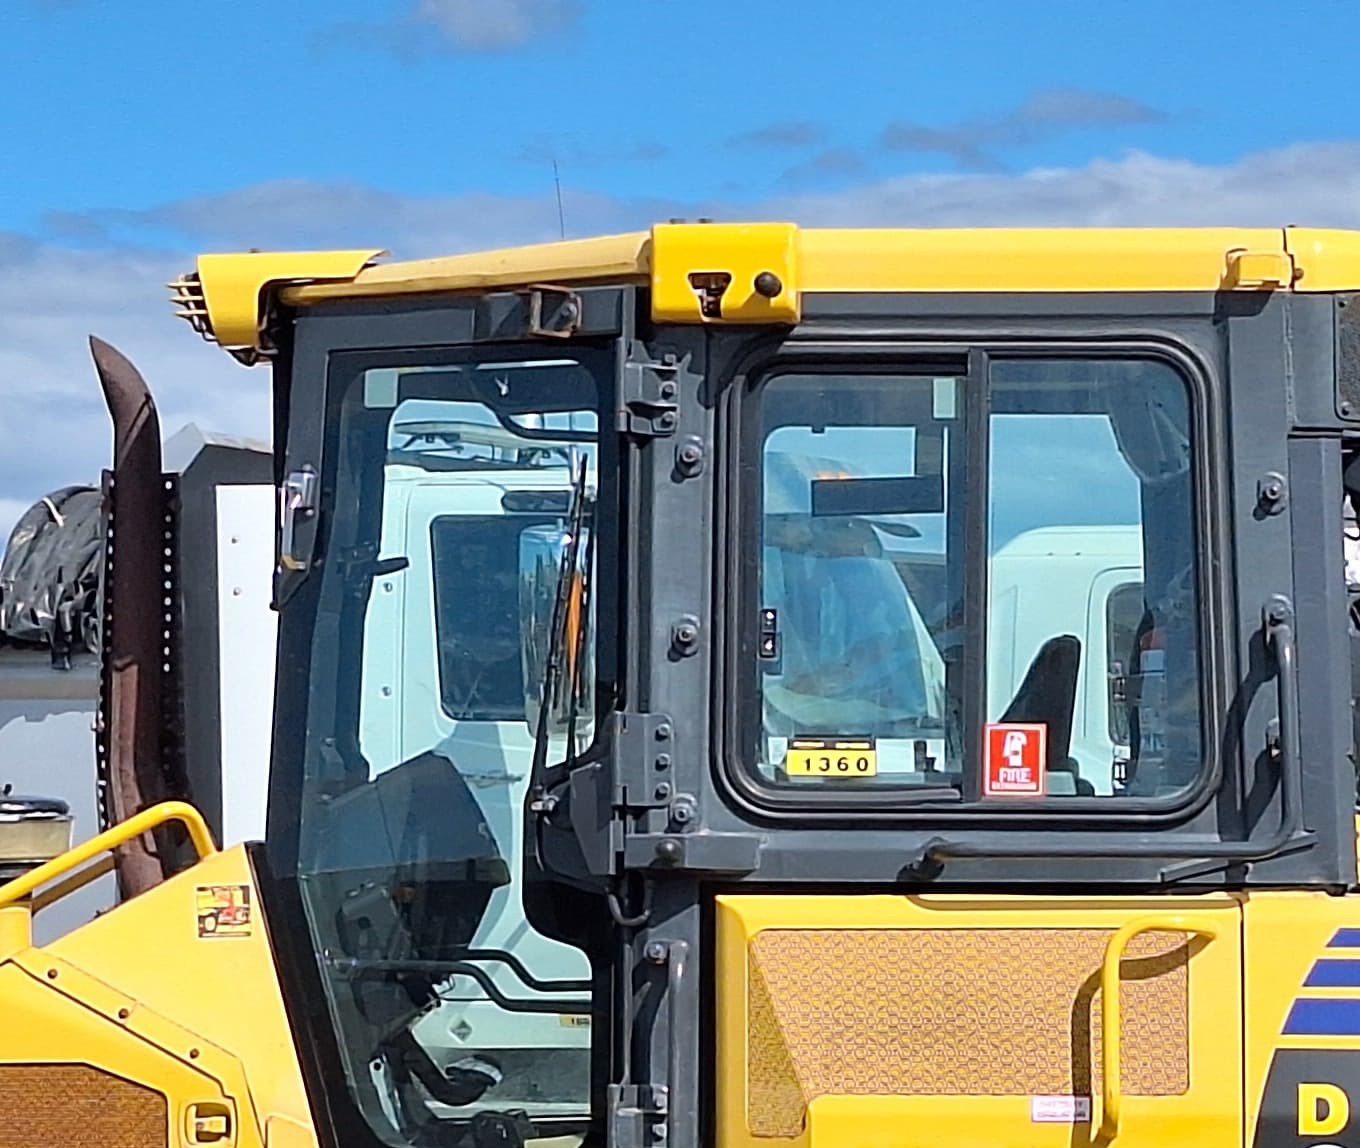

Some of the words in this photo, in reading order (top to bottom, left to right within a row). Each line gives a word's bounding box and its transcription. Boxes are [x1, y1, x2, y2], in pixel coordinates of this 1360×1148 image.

[805, 757, 869, 772] 1360
[999, 767, 1032, 782] FIRE
[1298, 1083, 1350, 1136] D
